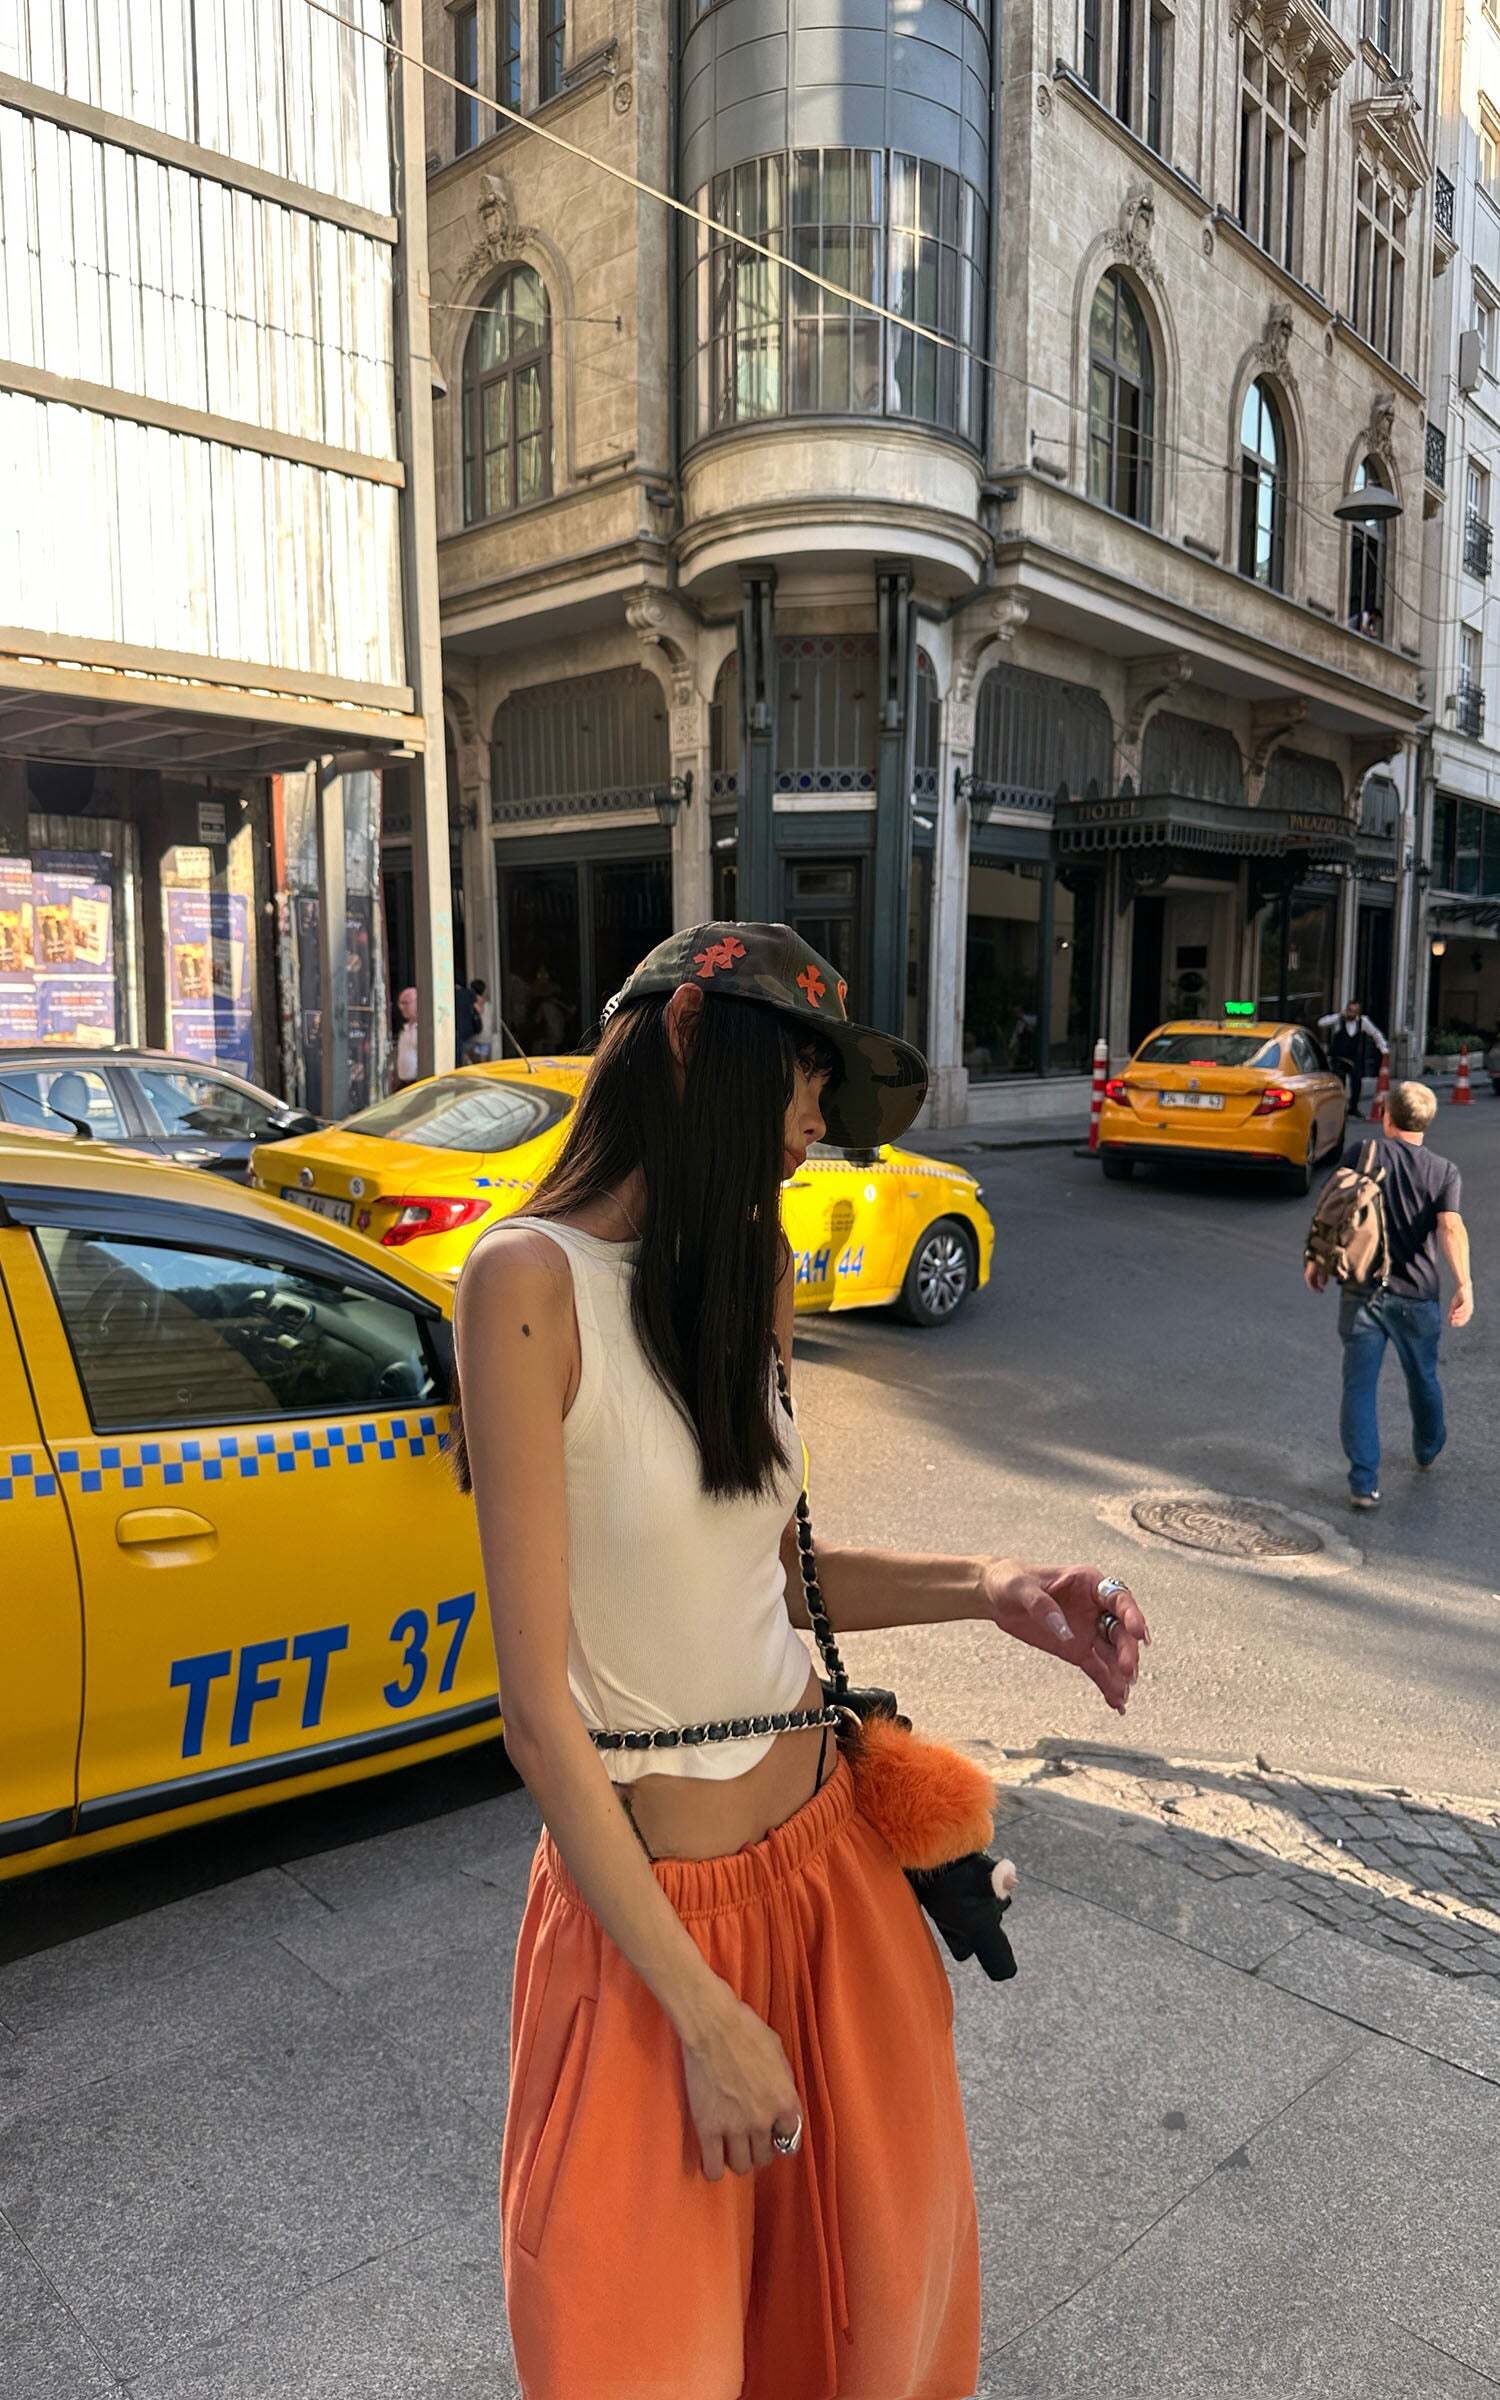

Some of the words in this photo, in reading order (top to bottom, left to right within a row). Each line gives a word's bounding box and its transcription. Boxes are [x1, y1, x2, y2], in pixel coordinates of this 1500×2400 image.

[1078, 801, 1139, 819] HOTEL
[838, 1244, 865, 1279] 44
[168, 1625, 350, 1758] TFT
[383, 1592, 476, 1709] 37
